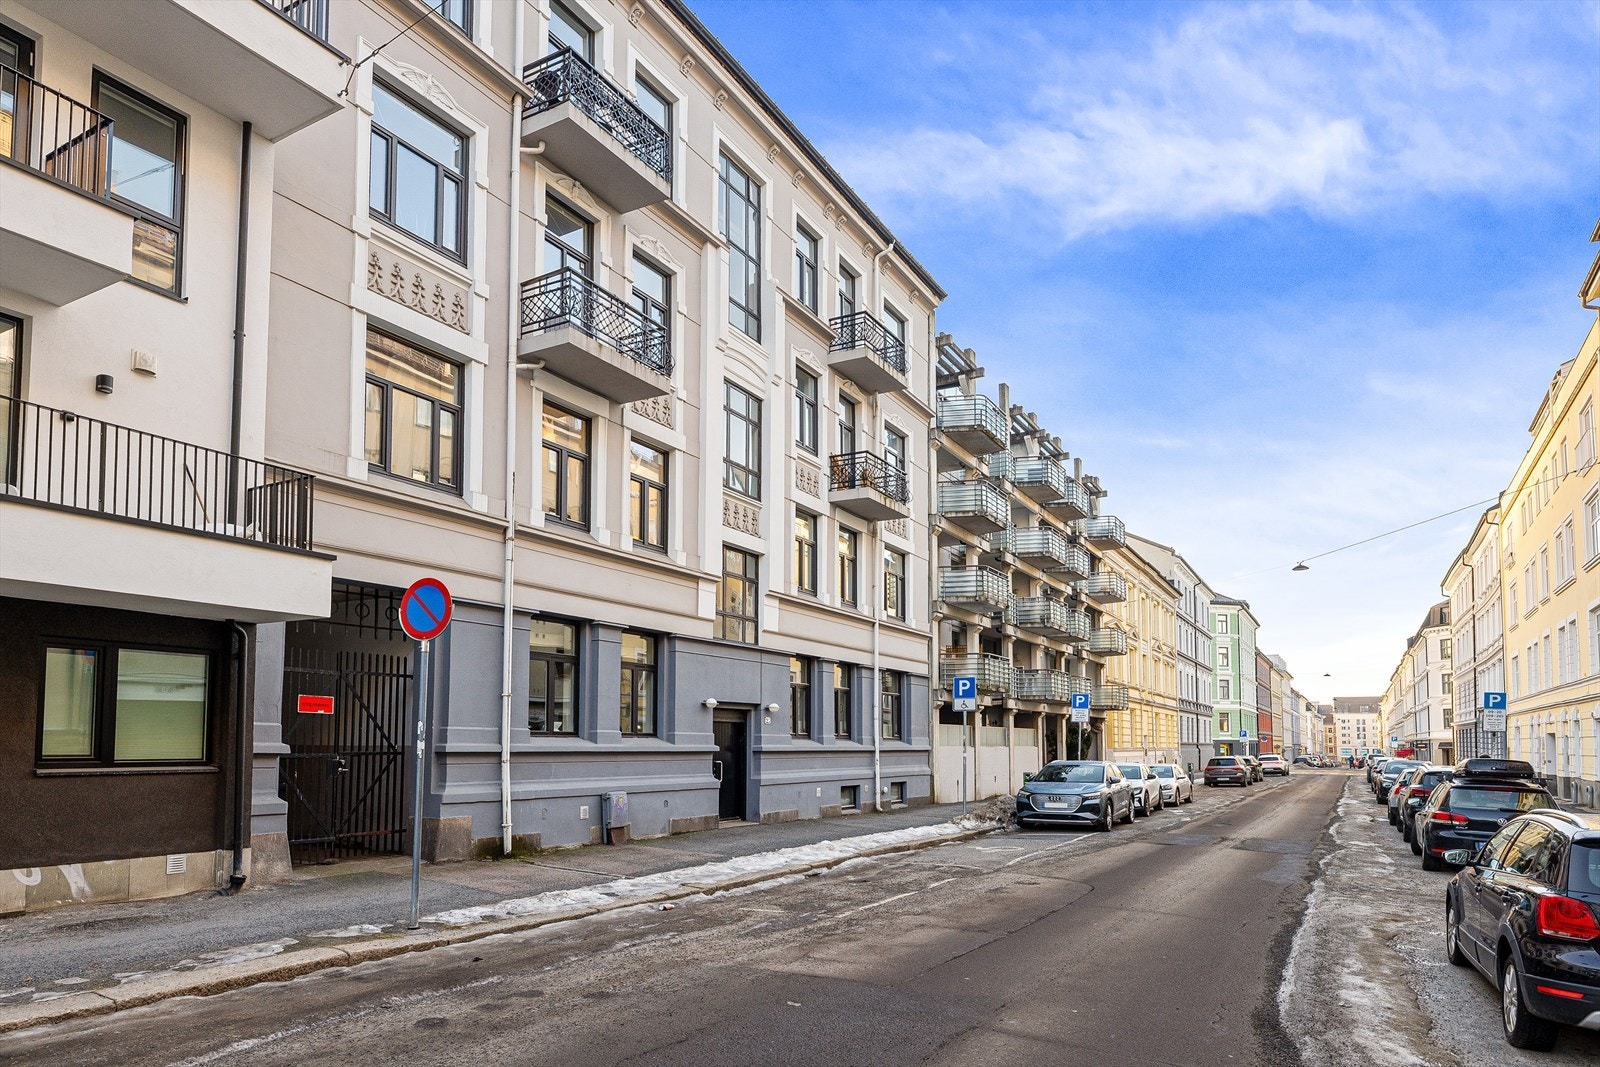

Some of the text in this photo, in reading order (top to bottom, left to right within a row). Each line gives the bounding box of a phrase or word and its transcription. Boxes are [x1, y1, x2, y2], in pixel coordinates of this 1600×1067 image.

[959, 680, 970, 696] P
[1076, 695, 1085, 707] P
[1489, 694, 1501, 707] P
